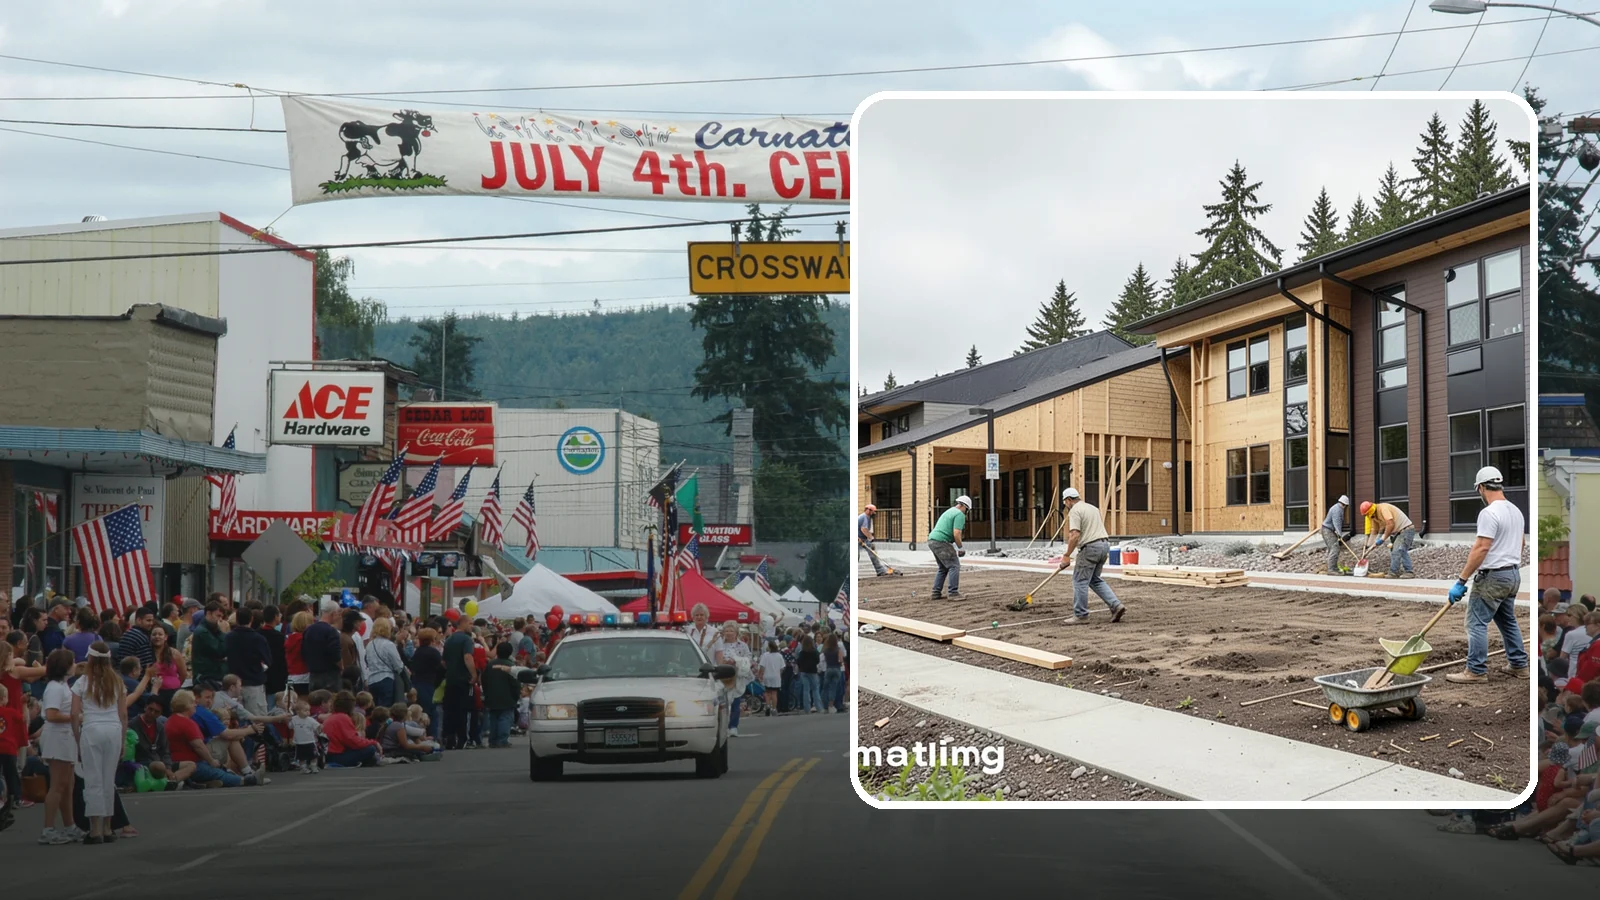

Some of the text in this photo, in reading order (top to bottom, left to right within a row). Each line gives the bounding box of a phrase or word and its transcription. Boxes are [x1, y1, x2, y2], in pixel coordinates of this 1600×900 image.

[481, 140, 604, 192] JULY
[632, 150, 747, 198] 4th.
[697, 254, 850, 280] CROSSWA
[283, 380, 373, 420] ACE
[405, 409, 452, 422] CEDAR
[283, 421, 371, 437] Hardware
[416, 428, 476, 447] Coca-Cola
[83, 484, 155, 496] St. Vincent de Paul
[212, 516, 331, 536] HARDARE
[688, 526, 742, 535] CRNATION
[699, 535, 730, 544] GLASS
